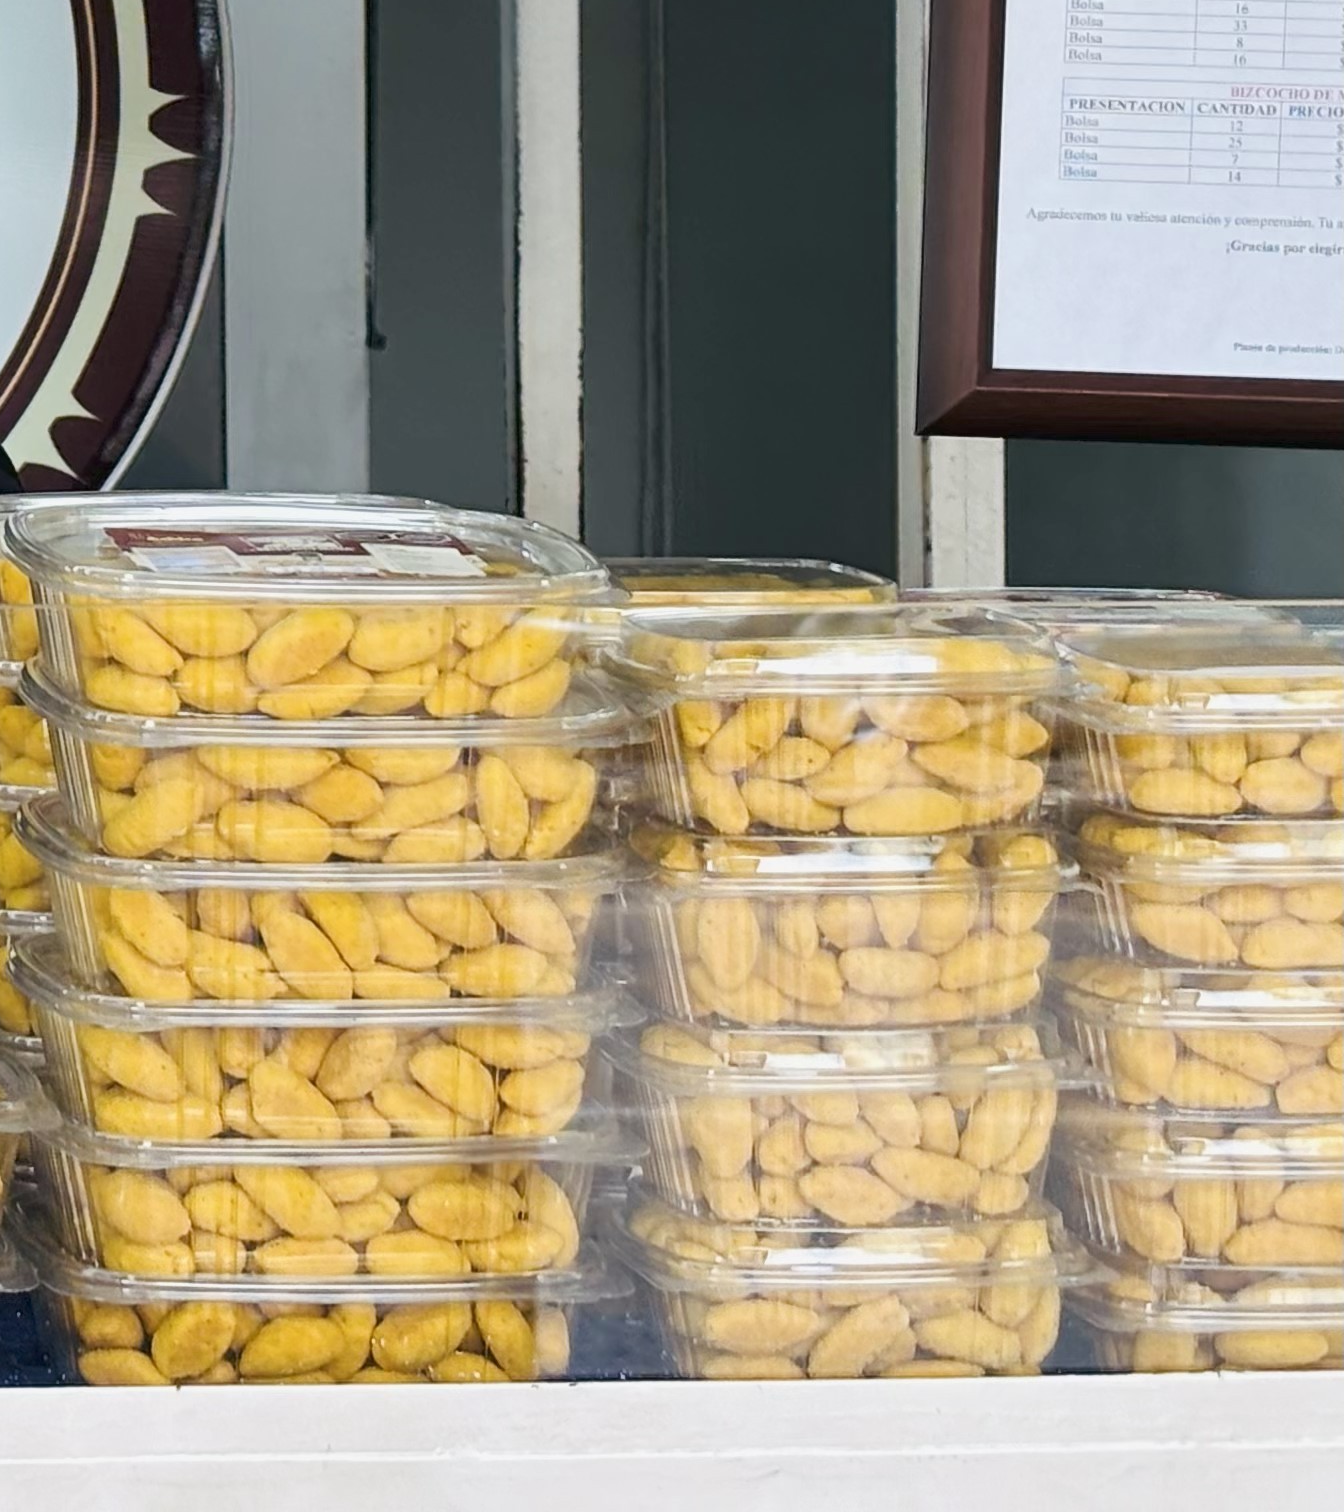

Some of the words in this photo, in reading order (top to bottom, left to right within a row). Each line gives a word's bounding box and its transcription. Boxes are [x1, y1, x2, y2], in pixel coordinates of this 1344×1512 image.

[1070, 15, 1103, 27] Bolsa
[1069, 32, 1102, 44] Bolsa
[1236, 37, 1243, 48] 8
[1068, 49, 1102, 61] Bolsa
[1231, 87, 1310, 99] BIZCOCHO
[1070, 98, 1185, 112] PRESENTACION
[1197, 102, 1277, 116] CANTIDAD
[1065, 114, 1099, 127] Bolsa
[1065, 132, 1098, 144] Bolsa
[1064, 149, 1097, 161] Bolsa
[1063, 165, 1097, 178] Bolsa
[1026, 207, 1107, 222] Agradecemos
[1110, 211, 1122, 221] tu
[1170, 212, 1221, 225] atención
[1224, 217, 1232, 227] y
[1283, 244, 1306, 255] por
